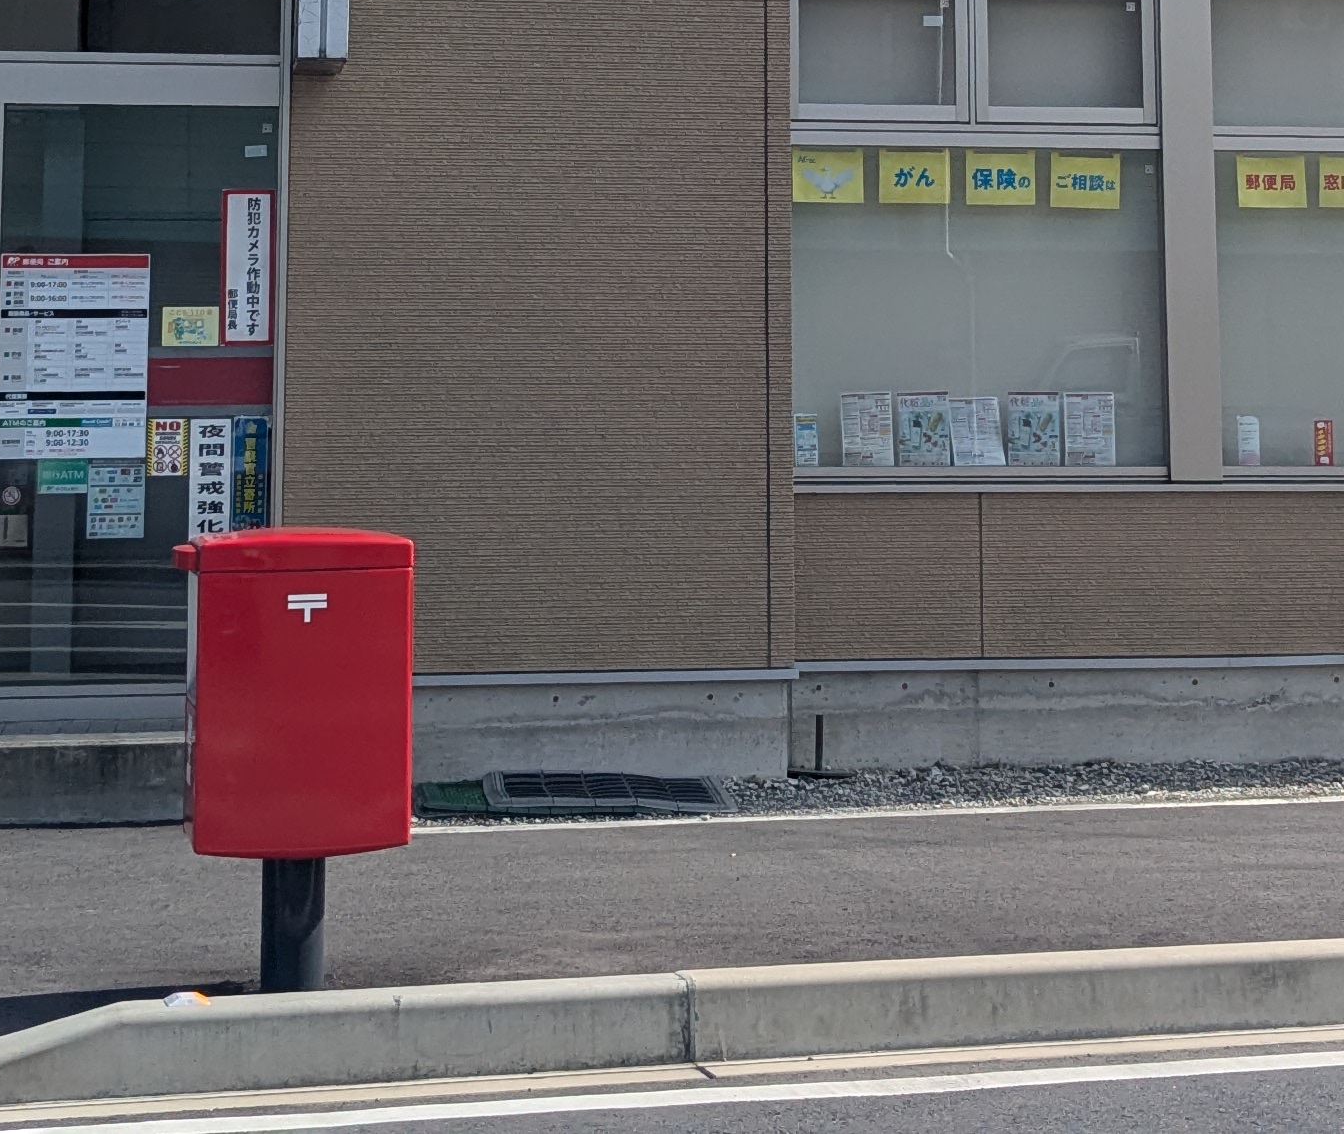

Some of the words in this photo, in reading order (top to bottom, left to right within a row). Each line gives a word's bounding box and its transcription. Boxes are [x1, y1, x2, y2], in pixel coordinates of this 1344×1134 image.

[893, 167, 936, 188] がん
[971, 167, 1032, 191] 保険の
[1056, 173, 1116, 192] ご相談は
[1245, 173, 1296, 191] 郵便局
[246, 197, 262, 337] 防犯カメラ作動中です
[227, 288, 239, 330] 郵便局長
[155, 421, 181, 431] NO
[196, 424, 227, 534] 夜間警戒強化
